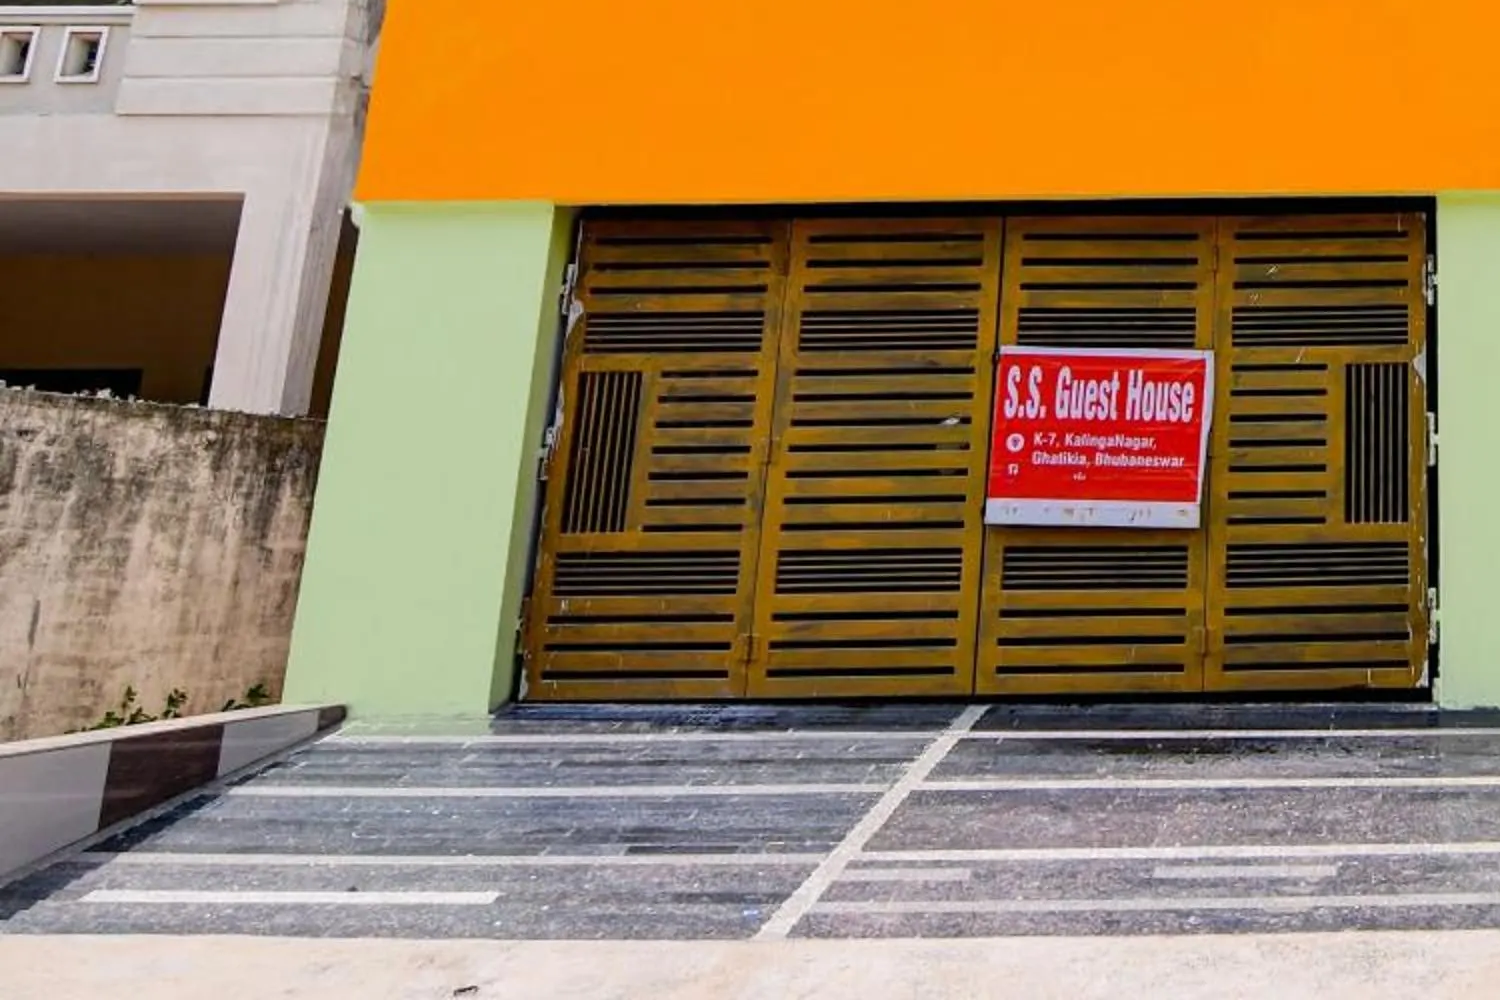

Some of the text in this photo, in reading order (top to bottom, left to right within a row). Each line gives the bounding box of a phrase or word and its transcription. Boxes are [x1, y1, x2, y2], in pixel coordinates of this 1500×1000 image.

[1004, 364, 1196, 423] S.S. Guest House
[1033, 431, 1060, 448] K-7,
[1095, 452, 1185, 468] Bhubaneswar
